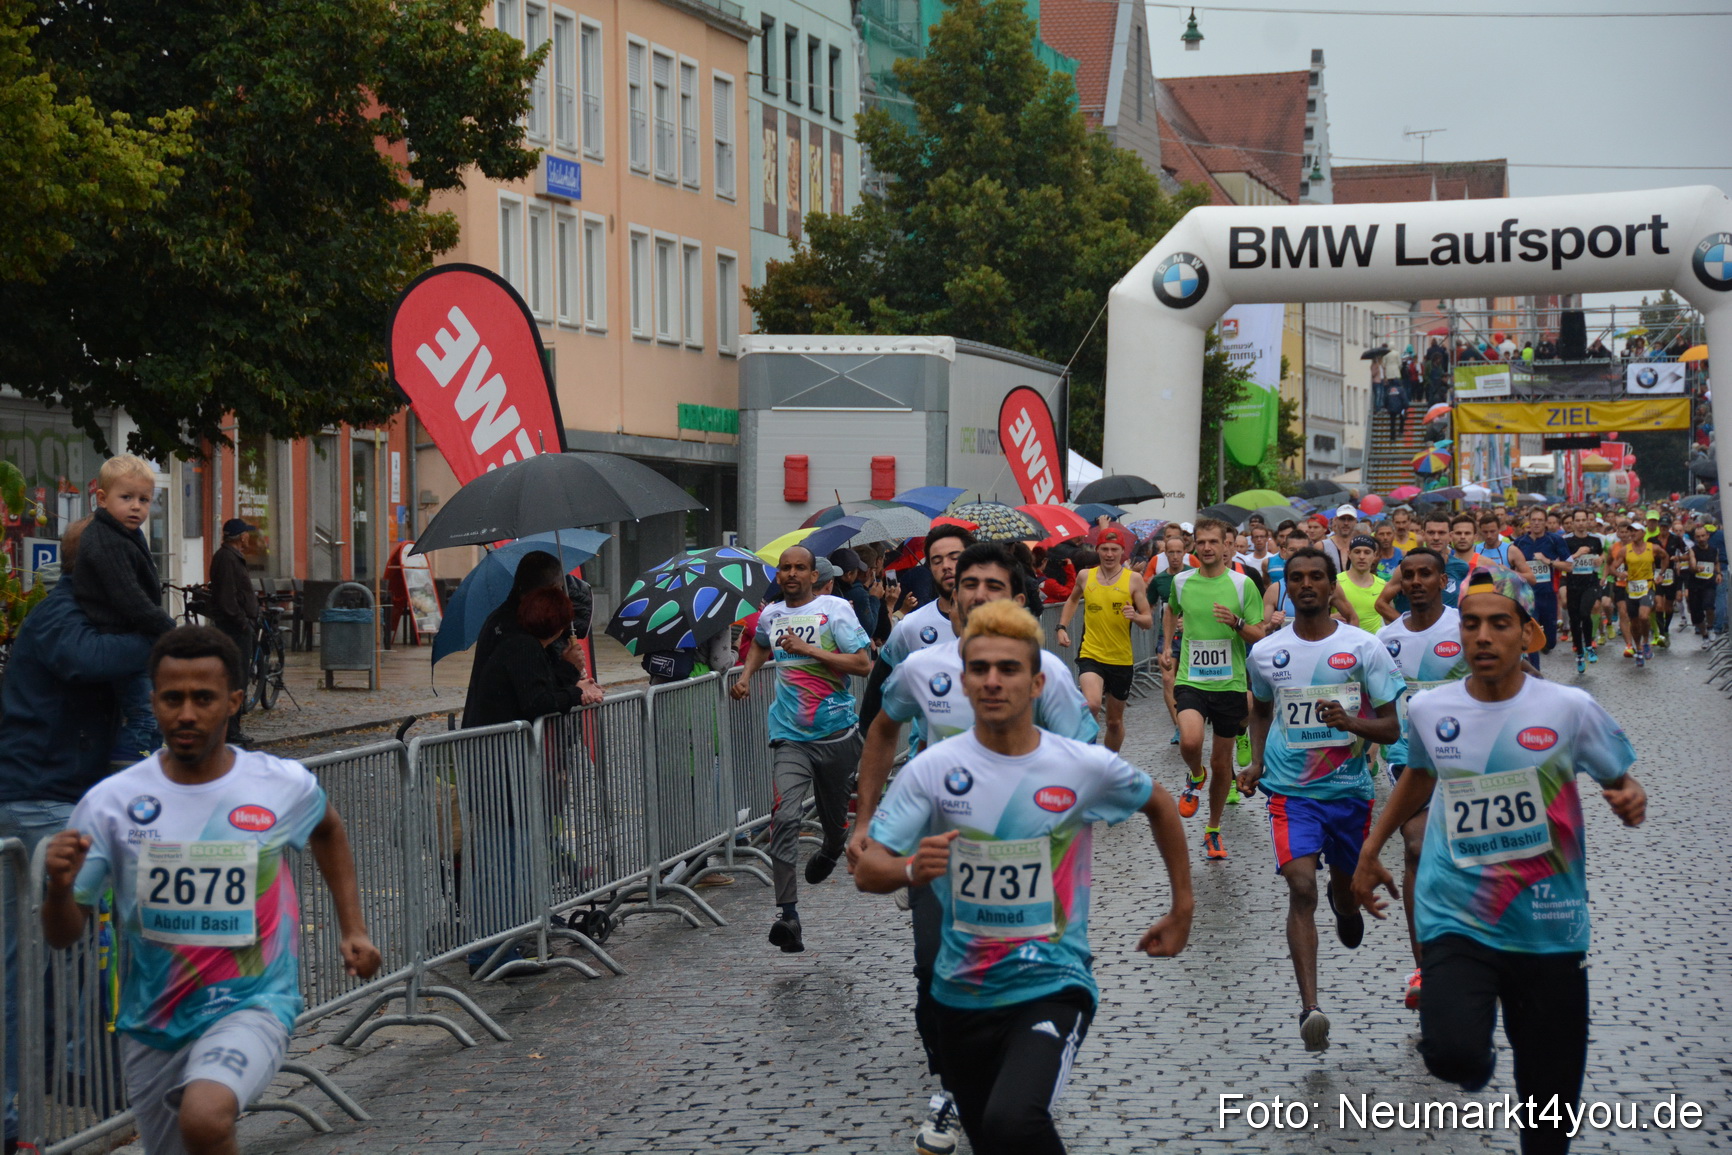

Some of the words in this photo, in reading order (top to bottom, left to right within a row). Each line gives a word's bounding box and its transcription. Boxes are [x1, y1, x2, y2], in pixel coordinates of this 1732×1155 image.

[1229, 224, 1379, 269] BMW
[1395, 214, 1670, 270] Laufsport
[1546, 407, 1598, 426] ZIEL
[39, 550, 52, 567] P
[1531, 565, 1548, 574] 580
[1193, 649, 1226, 665] 2001
[1272, 670, 1291, 678] PARTL
[928, 701, 951, 709] PARTL
[1301, 729, 1332, 740] Ahmad
[1522, 732, 1554, 745] Hervis
[1435, 746, 1460, 754] PARTL
[1480, 772, 1529, 789] BOCK
[942, 800, 972, 810] PARTL
[1040, 792, 1072, 807] Hervis
[235, 810, 271, 825] Hervis
[1454, 791, 1536, 833] 2736
[128, 829, 161, 838] PARTL
[189, 844, 247, 857] BOCK
[988, 842, 1040, 857] BOCK
[1458, 837, 1497, 856] Sayed
[1501, 831, 1541, 849] Bashir
[149, 867, 246, 905] 2678
[959, 862, 1041, 900] 2737
[1532, 884, 1555, 899] 17.
[154, 914, 195, 930] Abdul
[201, 915, 239, 931] Basit
[977, 909, 1024, 924] Ahmed
[1533, 910, 1575, 920] Stadtlauf
[1019, 945, 1043, 960] 17.
